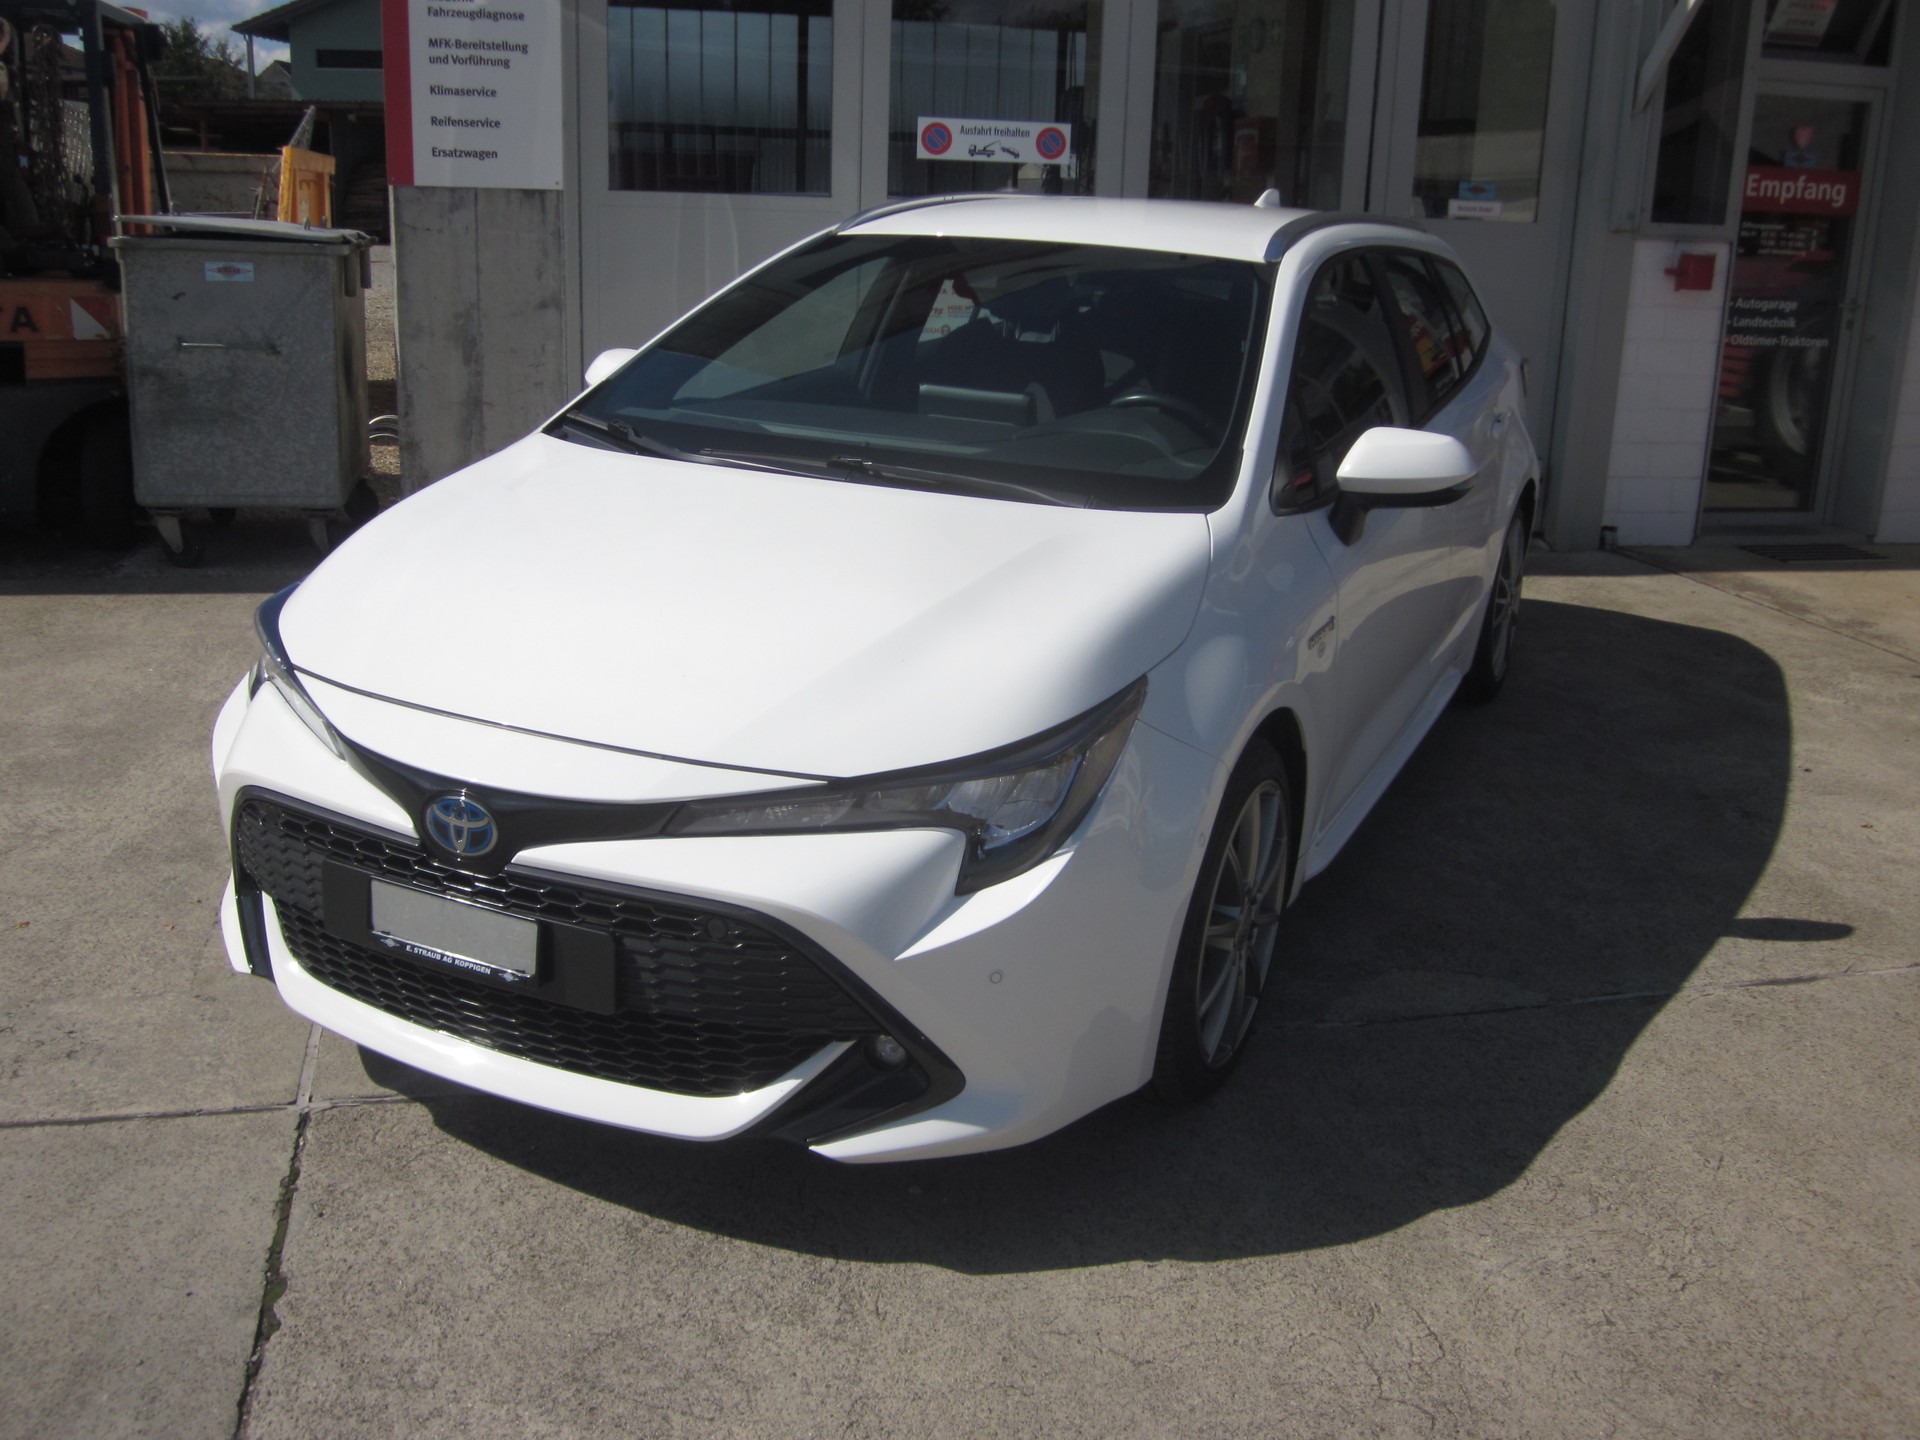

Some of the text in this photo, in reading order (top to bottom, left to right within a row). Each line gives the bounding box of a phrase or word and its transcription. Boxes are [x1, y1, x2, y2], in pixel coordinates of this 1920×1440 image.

[427, 6, 525, 22] Fahrzeugdiagnose
[428, 38, 529, 54] MFK-Bereitstellung
[429, 54, 510, 69] und Vorführung
[429, 85, 497, 98] Klimaservice
[430, 116, 501, 129] Reifenservice
[959, 125, 1031, 138] Ausfahrt freihalten
[431, 147, 498, 161] Ersatzwagen
[1746, 174, 1847, 208] Empfang
[1735, 298, 1798, 312] Autogarage
[1733, 316, 1797, 329] Landtechnik
[1731, 334, 1829, 348] Oldtimer-Traktoren
[406, 945, 491, 974] E. STRAUB AG KOPPIGEN
